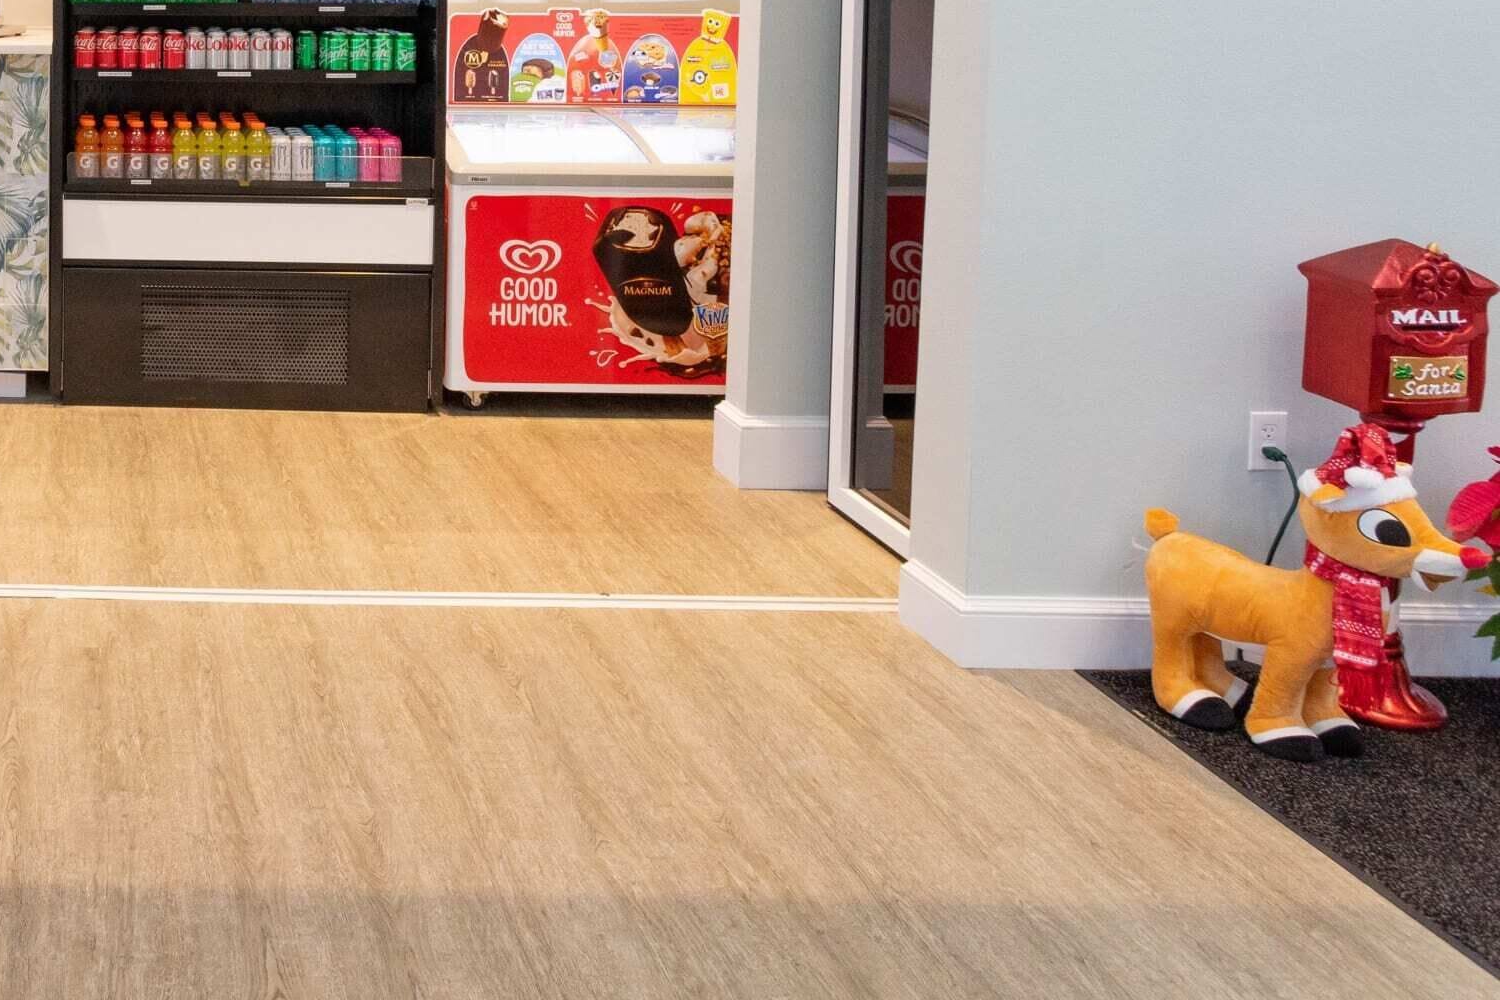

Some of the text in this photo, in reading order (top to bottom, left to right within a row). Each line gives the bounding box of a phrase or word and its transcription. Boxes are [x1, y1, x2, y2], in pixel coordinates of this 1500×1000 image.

[80, 156, 91, 168] G
[107, 156, 118, 168] G
[130, 156, 142, 169] G
[157, 157, 169, 169] G
[178, 156, 189, 169] G
[200, 157, 211, 169] G
[225, 157, 237, 170] G
[250, 158, 262, 170] G
[500, 277, 558, 301] GOOD
[489, 303, 568, 327] HUMOR
[1391, 308, 1467, 325] MAIL
[1414, 362, 1451, 381] for
[1400, 380, 1461, 396] Santa
